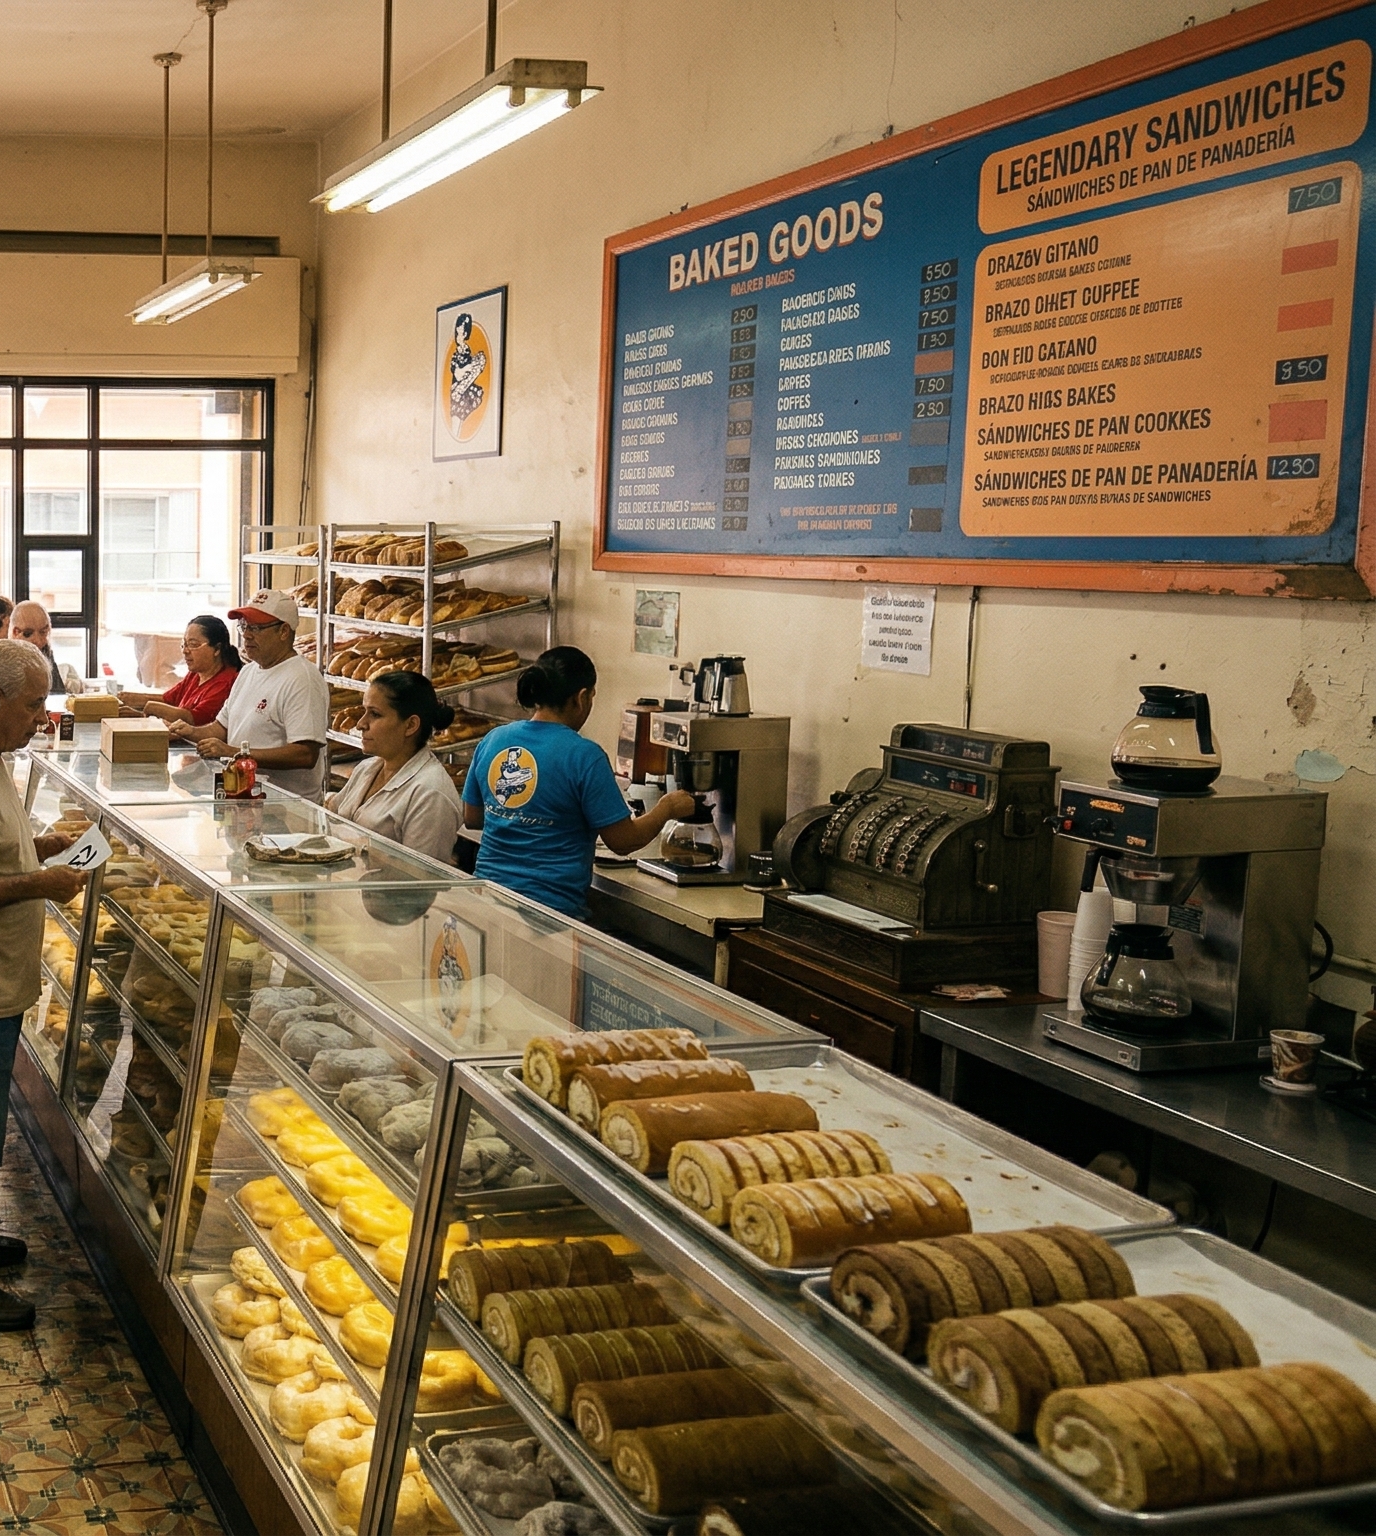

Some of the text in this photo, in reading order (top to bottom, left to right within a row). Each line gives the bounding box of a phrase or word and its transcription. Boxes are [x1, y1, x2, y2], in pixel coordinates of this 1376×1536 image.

[996, 60, 1346, 195] LEGENDARY SANDWICHES
[1027, 123, 1295, 213] SÁNDWICHES DE PAN DE PANADERÍA
[1294, 181, 1336, 211] 750
[669, 231, 759, 292] BAKED
[768, 192, 883, 264] GOODS
[1046, 235, 1099, 264] GITANO
[985, 298, 1031, 323] BRAZO
[979, 393, 1024, 416] BRAZO
[1066, 383, 1116, 407] BAKES
[977, 420, 1070, 446] SÁNDWICHES
[1074, 419, 1095, 438] DE
[1099, 416, 1129, 436] PAN
[974, 454, 1258, 491] SÁNDWICHES DE PAN DE PANADERÍA
[1147, 490, 1212, 503] SANDWICHES
